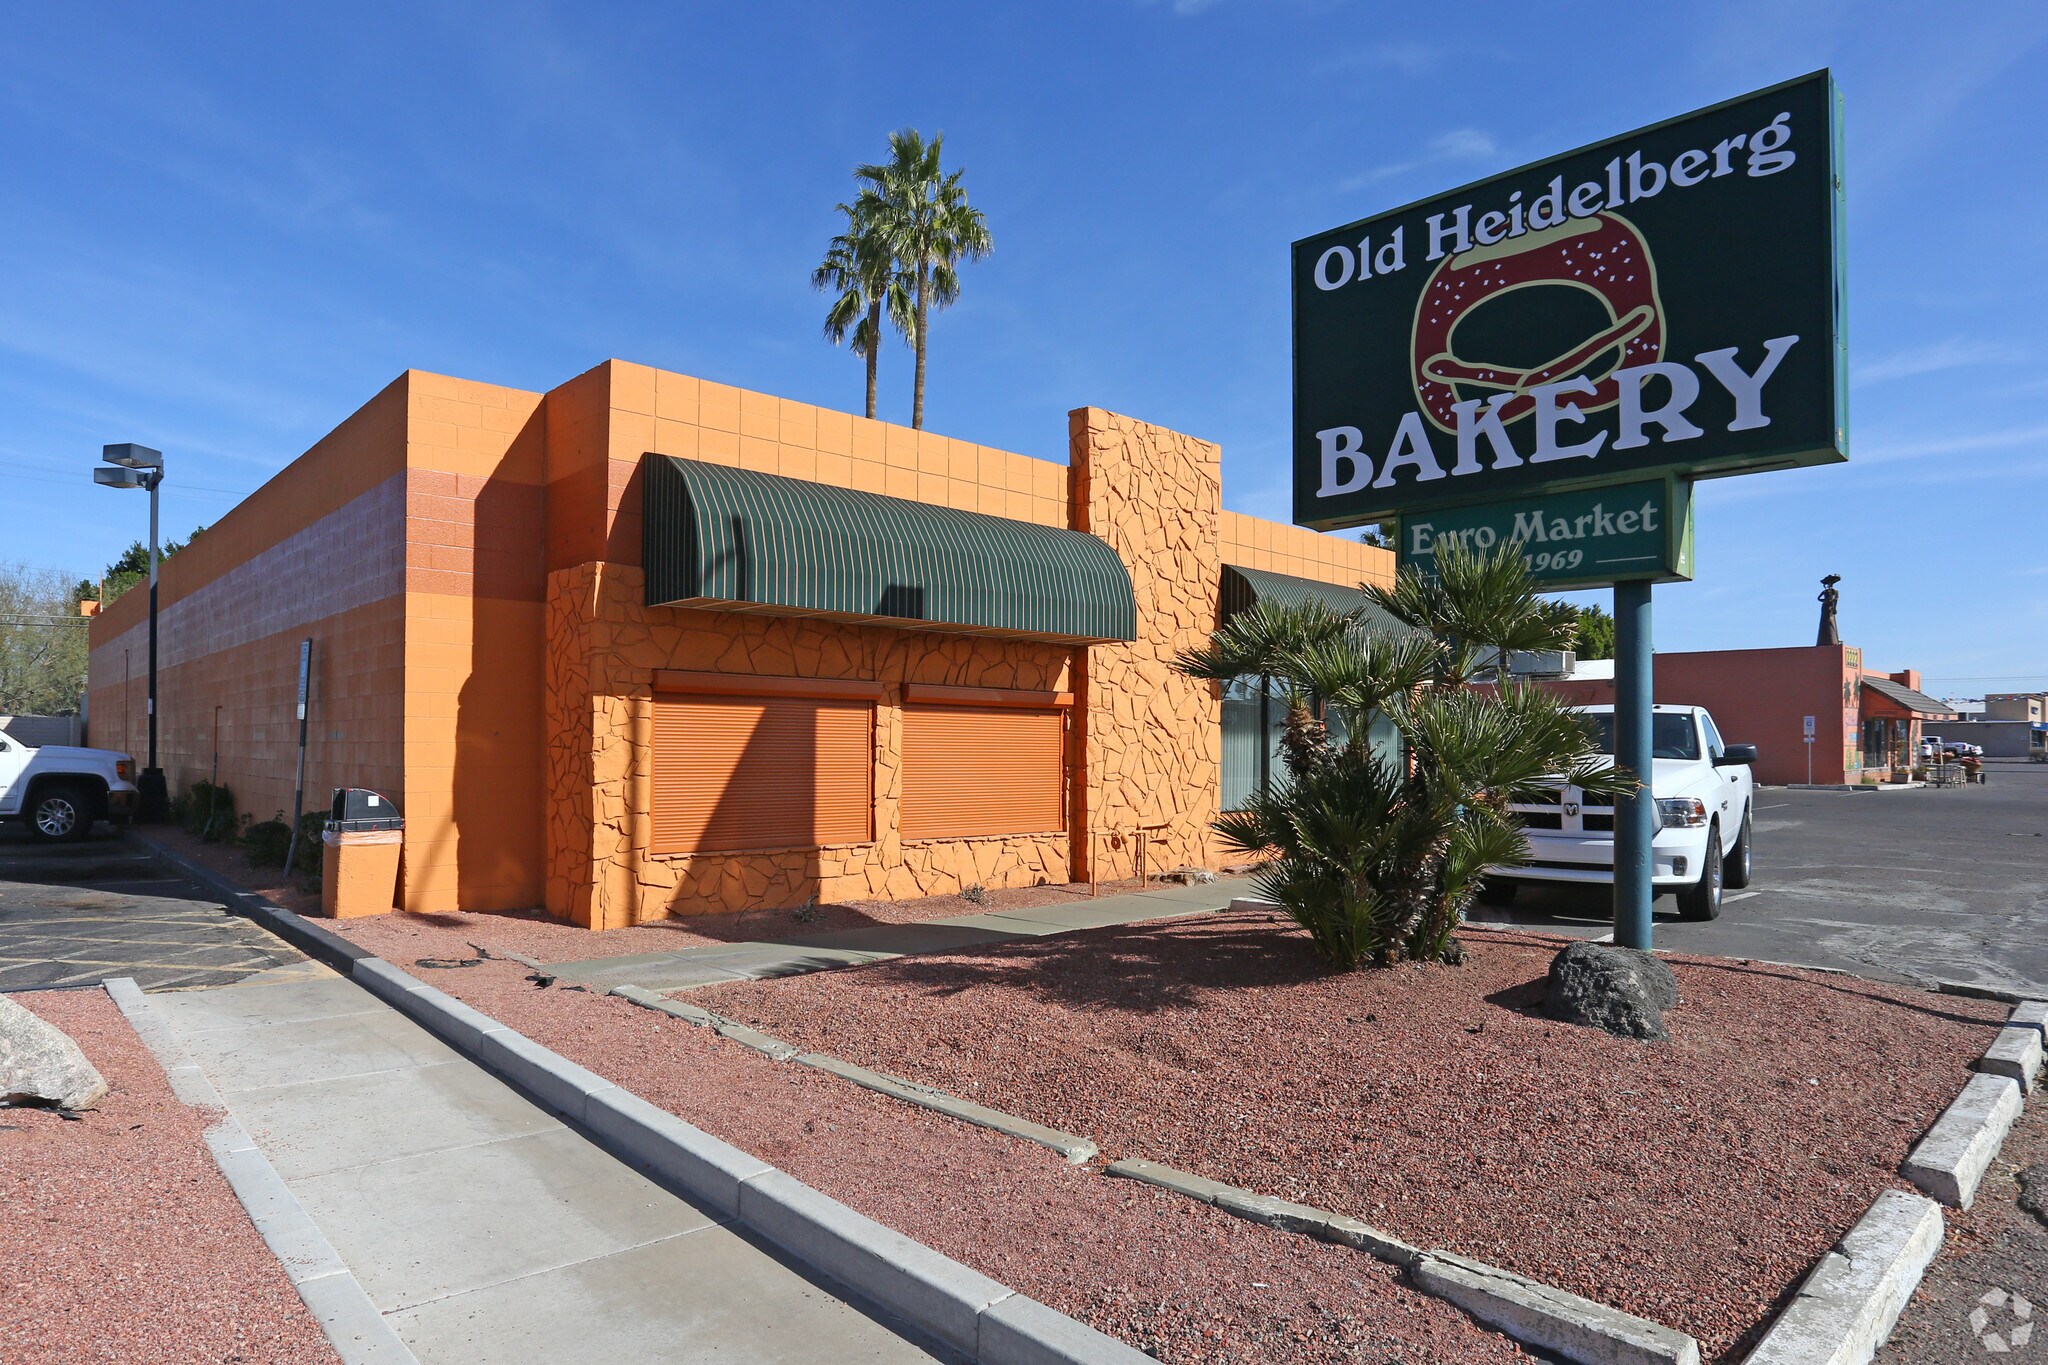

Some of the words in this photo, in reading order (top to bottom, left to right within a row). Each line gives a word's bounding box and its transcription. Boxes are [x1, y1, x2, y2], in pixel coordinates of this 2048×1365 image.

[1314, 226, 1406, 291] Old
[1426, 111, 1796, 261] Heidelberg
[1316, 334, 1800, 498] BAKERY
[1511, 500, 1658, 545] Market
[1524, 549, 1583, 572] 1969
